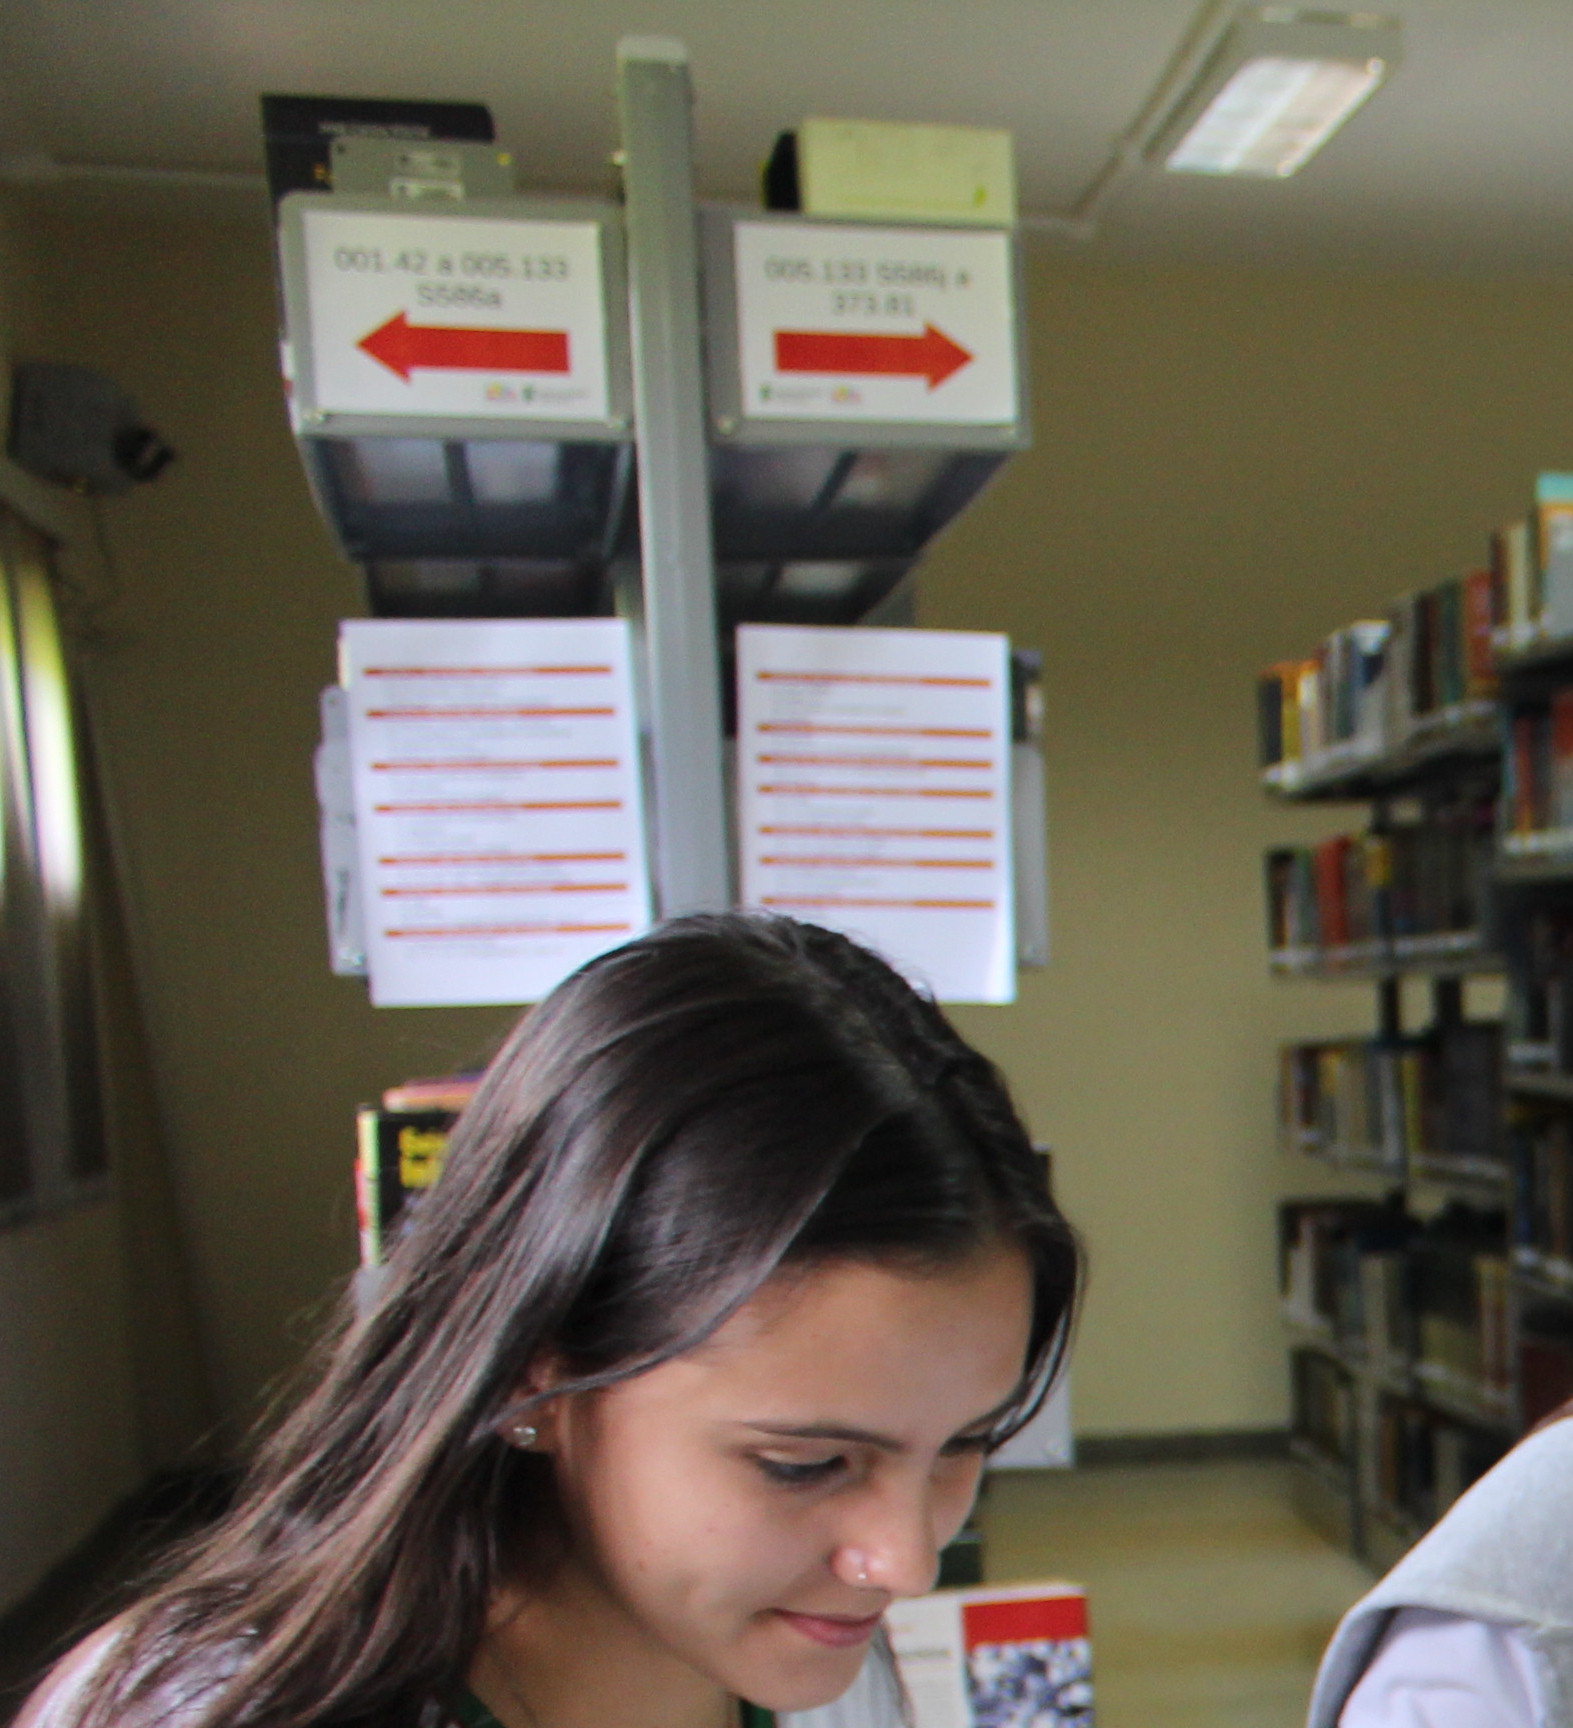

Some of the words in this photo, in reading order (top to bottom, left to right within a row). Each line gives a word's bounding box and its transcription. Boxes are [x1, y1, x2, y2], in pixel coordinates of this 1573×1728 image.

[334, 246, 427, 274] 001.42
[437, 254, 453, 276] a
[460, 251, 571, 281] 005.133
